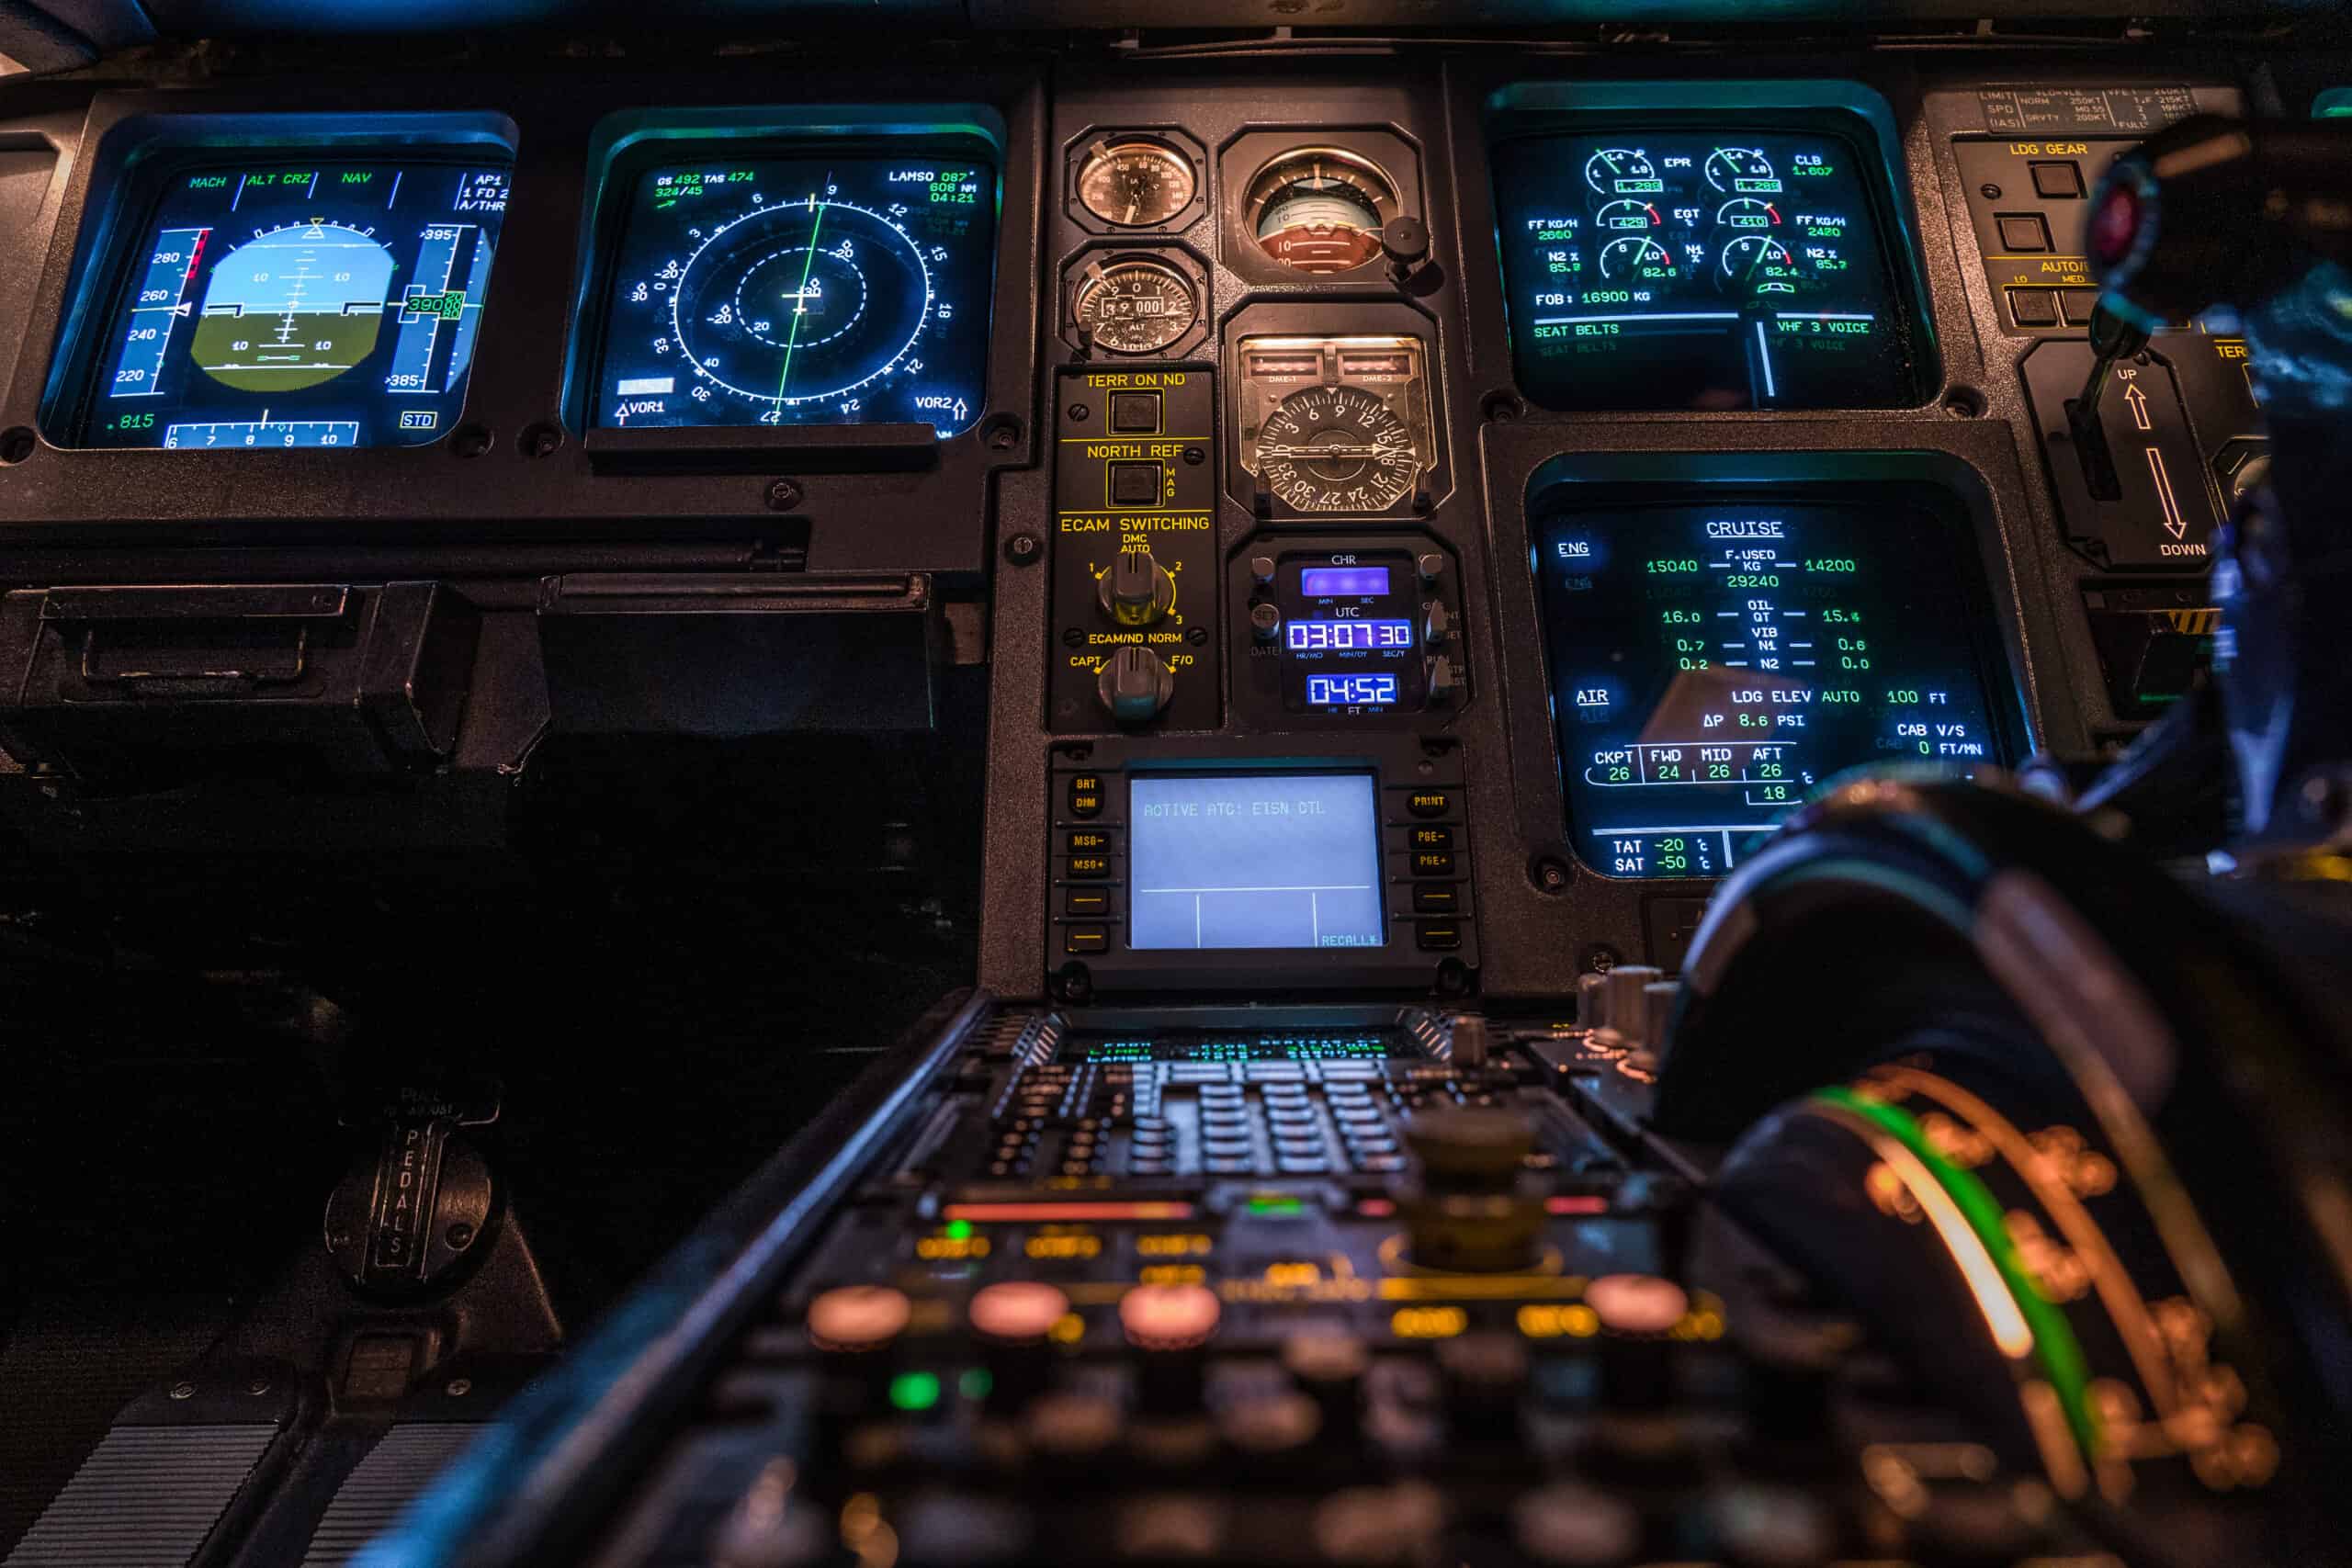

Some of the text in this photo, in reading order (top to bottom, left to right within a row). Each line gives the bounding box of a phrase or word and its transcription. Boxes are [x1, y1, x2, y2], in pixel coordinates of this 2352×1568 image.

[2009, 144, 2087, 155] LDG GEAR
[1664, 158, 1692, 167] EPR
[1794, 155, 1823, 165] CLB
[188, 176, 227, 187] MACH
[246, 173, 312, 186] ALT CRZ
[341, 172, 372, 184] NAV
[474, 175, 503, 186] AP1
[674, 174, 701, 185] 492
[727, 171, 755, 182] 474
[888, 171, 934, 182] LAMSO
[475, 187, 496, 198] FD
[458, 200, 506, 211] A/THR
[888, 203, 908, 217] 12
[1674, 209, 1701, 220] EGT
[1795, 216, 1814, 225] FF
[1528, 220, 1545, 230] FF
[424, 230, 452, 241] 395
[152, 252, 180, 264] 280
[931, 246, 948, 262] 15
[1548, 252, 1567, 262] N2
[1806, 248, 1826, 258] N2
[2041, 261, 2088, 273] AUTO/
[2014, 275, 2028, 283] LO
[2062, 275, 2086, 284] MED
[141, 289, 168, 301] 260
[1581, 291, 1629, 304] 16900
[1634, 292, 1650, 302] KG
[752, 321, 770, 332] 20
[1129, 323, 1145, 332] ALT
[1534, 323, 1620, 338] SEAT BELTS
[1777, 322, 1870, 333] VHF VOICE
[128, 328, 156, 340] 240
[2216, 345, 2247, 358] TER
[703, 357, 719, 367] 40
[116, 369, 144, 381] 220
[1088, 373, 1186, 387] TERR ON ND
[2118, 369, 2138, 380] UP
[390, 375, 419, 387] 385
[628, 400, 664, 413] VOR1
[915, 396, 953, 409] VOR2
[1308, 409, 1320, 421] 6
[1335, 405, 1346, 418] 9
[402, 414, 433, 427] STD
[1356, 412, 1375, 428] 12
[1285, 423, 1300, 434] 3
[1087, 445, 1184, 458] NORTH REF
[1278, 462, 1297, 480] 33
[1166, 468, 1176, 497] MAG
[1370, 472, 1389, 489] 21
[1294, 479, 1317, 499] 30
[1347, 487, 1369, 502] 24
[1319, 491, 1341, 505] 27
[1061, 517, 1210, 532] ECAM SWITCHING
[1706, 521, 1784, 536] CRUISE
[1123, 534, 1148, 543] DMC
[1120, 544, 1150, 553] AUTO
[1558, 543, 1589, 555] ENG
[1725, 549, 1776, 560] F.USED
[2161, 544, 2207, 557] DOWN
[1331, 555, 1357, 565] CHR
[1647, 558, 1856, 574] 15040 KG 14200
[1726, 575, 1780, 588] 29240
[1747, 599, 1774, 611] OIL
[1335, 606, 1361, 617] UTC
[1662, 610, 1701, 624] 16.0
[1088, 633, 1182, 644] ECAM/ND NORM
[1289, 624, 1409, 649] 03:07 30
[1751, 627, 1779, 639] VIB
[1677, 638, 1866, 652] 0.7 N1 0.6
[1069, 657, 1102, 667] CAPT
[1171, 655, 1194, 665] F/O
[1679, 657, 1870, 671] 0.2 N2 0.0
[1310, 677, 1396, 704] 04:52
[1576, 689, 1610, 703] AIR
[1732, 690, 1947, 705] LDG ELEV AUTO 100 FT
[1738, 714, 1770, 727] 8.6
[1777, 715, 1805, 727] PSI
[1896, 724, 1965, 737] CAB V/S
[1594, 747, 1782, 764] CKPT FWD MID AFT
[1939, 743, 1983, 756] FT/MN
[1609, 764, 1782, 781] 26 24 26 26
[1076, 779, 1096, 789] BRT
[1764, 785, 1786, 800] 18
[1076, 797, 1096, 808] DIM
[1413, 796, 1445, 807] PRINT
[1613, 839, 1684, 853] TAT -20
[1615, 855, 1687, 872] SAT -50
[390, 1129, 419, 1254] PEDALS
